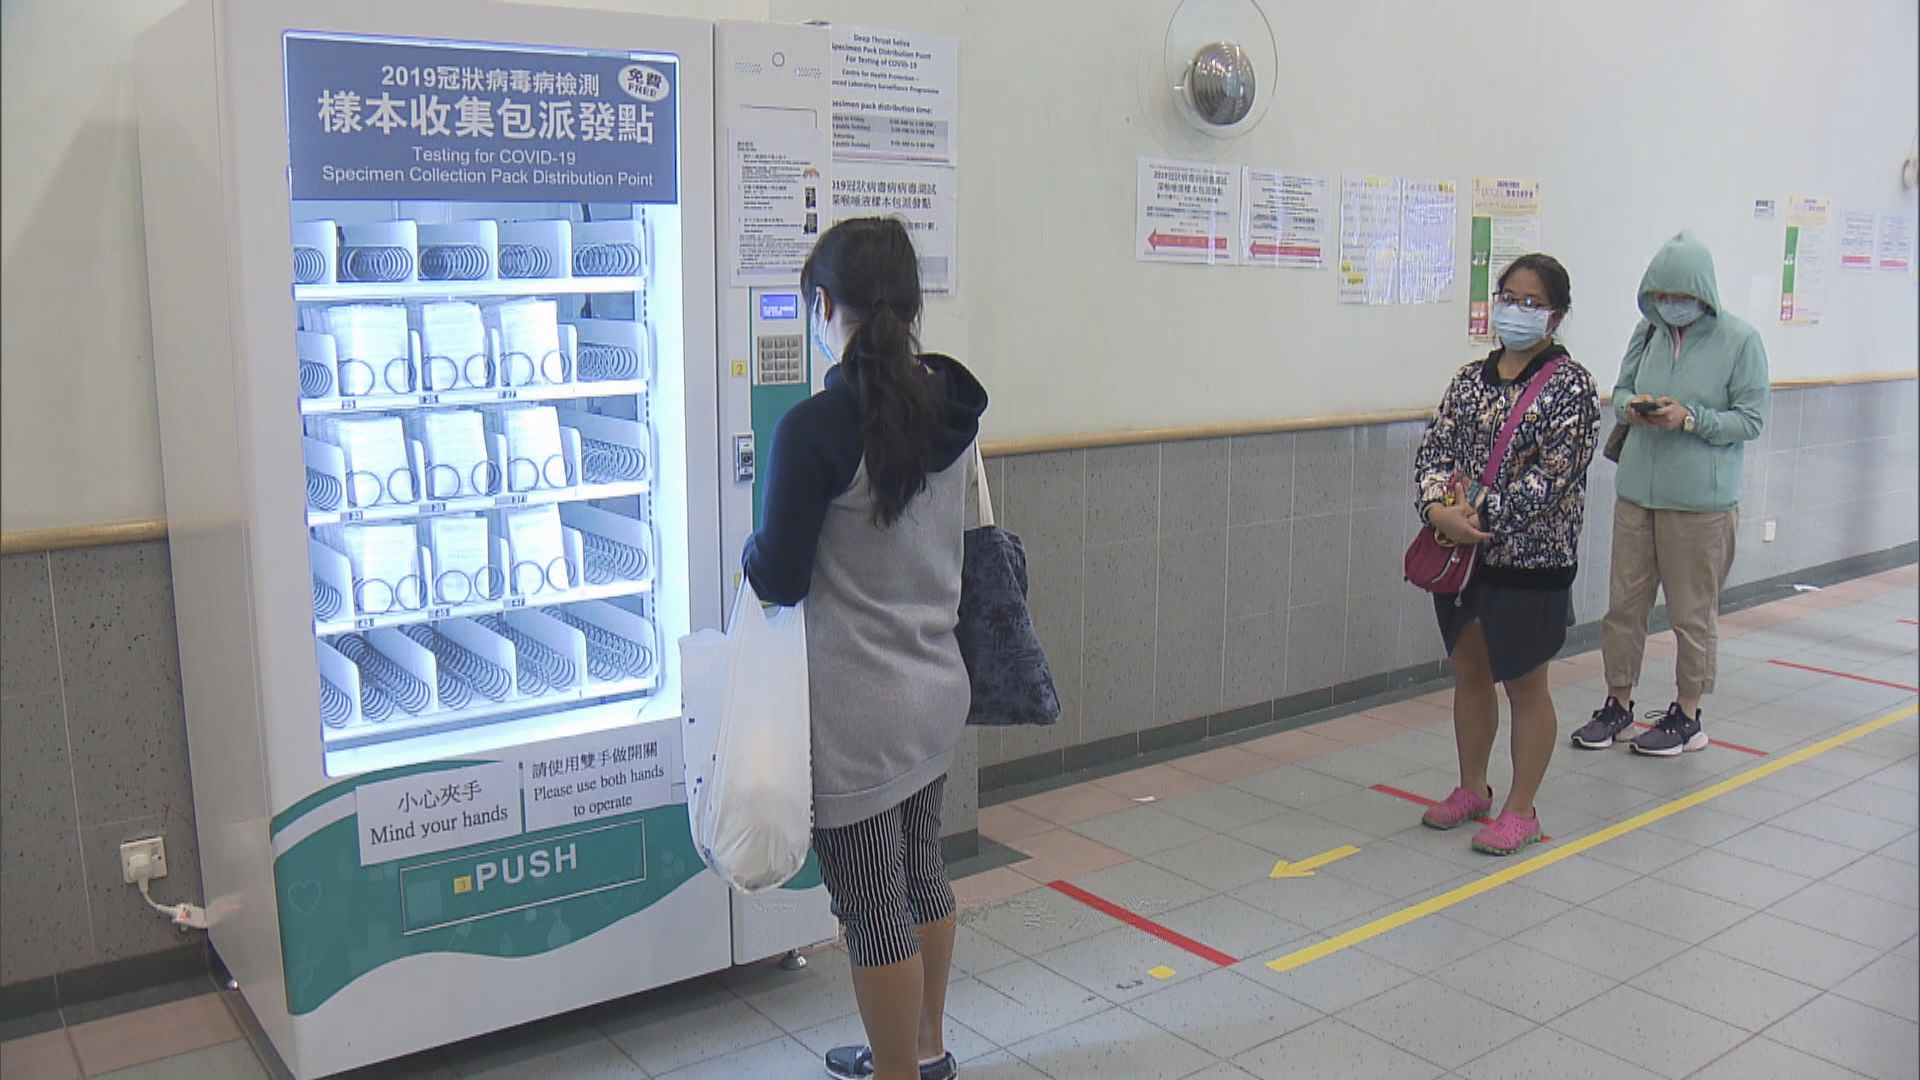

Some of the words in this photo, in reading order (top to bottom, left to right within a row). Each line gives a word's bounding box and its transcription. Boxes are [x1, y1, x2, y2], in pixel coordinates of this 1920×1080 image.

[854, 34, 870, 42] Deep
[872, 36, 892, 45] Throat
[893, 38, 910, 47] Saliva
[846, 54, 856, 63] For
[858, 56, 879, 66] Testing
[863, 44, 876, 54] Pack
[879, 48, 914, 58] Distribution
[916, 52, 931, 60] Point
[382, 65, 600, 97] 2019冠狀病毒病檢測
[627, 68, 663, 87] 免費
[848, 80, 876, 90] Laboratory
[878, 84, 908, 92] Surveillance
[910, 86, 939, 94] Programme
[628, 83, 658, 98] FREE
[318, 90, 654, 144] 樣本收集包派發點
[878, 102, 915, 113] distribution
[412, 146, 470, 165] Testing
[474, 148, 495, 164] for
[500, 150, 576, 165] COVID-19
[322, 166, 404, 184] Specimen
[409, 168, 486, 184] Collection
[491, 170, 528, 184] Pack
[533, 170, 614, 185] Distribution
[618, 172, 654, 187] Point
[532, 740, 658, 779] 請使用雙手做開關
[534, 782, 572, 801] Please
[576, 779, 596, 792] use
[600, 773, 627, 789] both
[630, 766, 664, 783] hands
[398, 780, 482, 813] 小心夾手
[574, 803, 586, 817] to
[588, 794, 633, 815] operate
[370, 821, 416, 846] Mind
[421, 816, 458, 838] your
[462, 805, 508, 828] hands
[475, 842, 578, 892] PUSH
